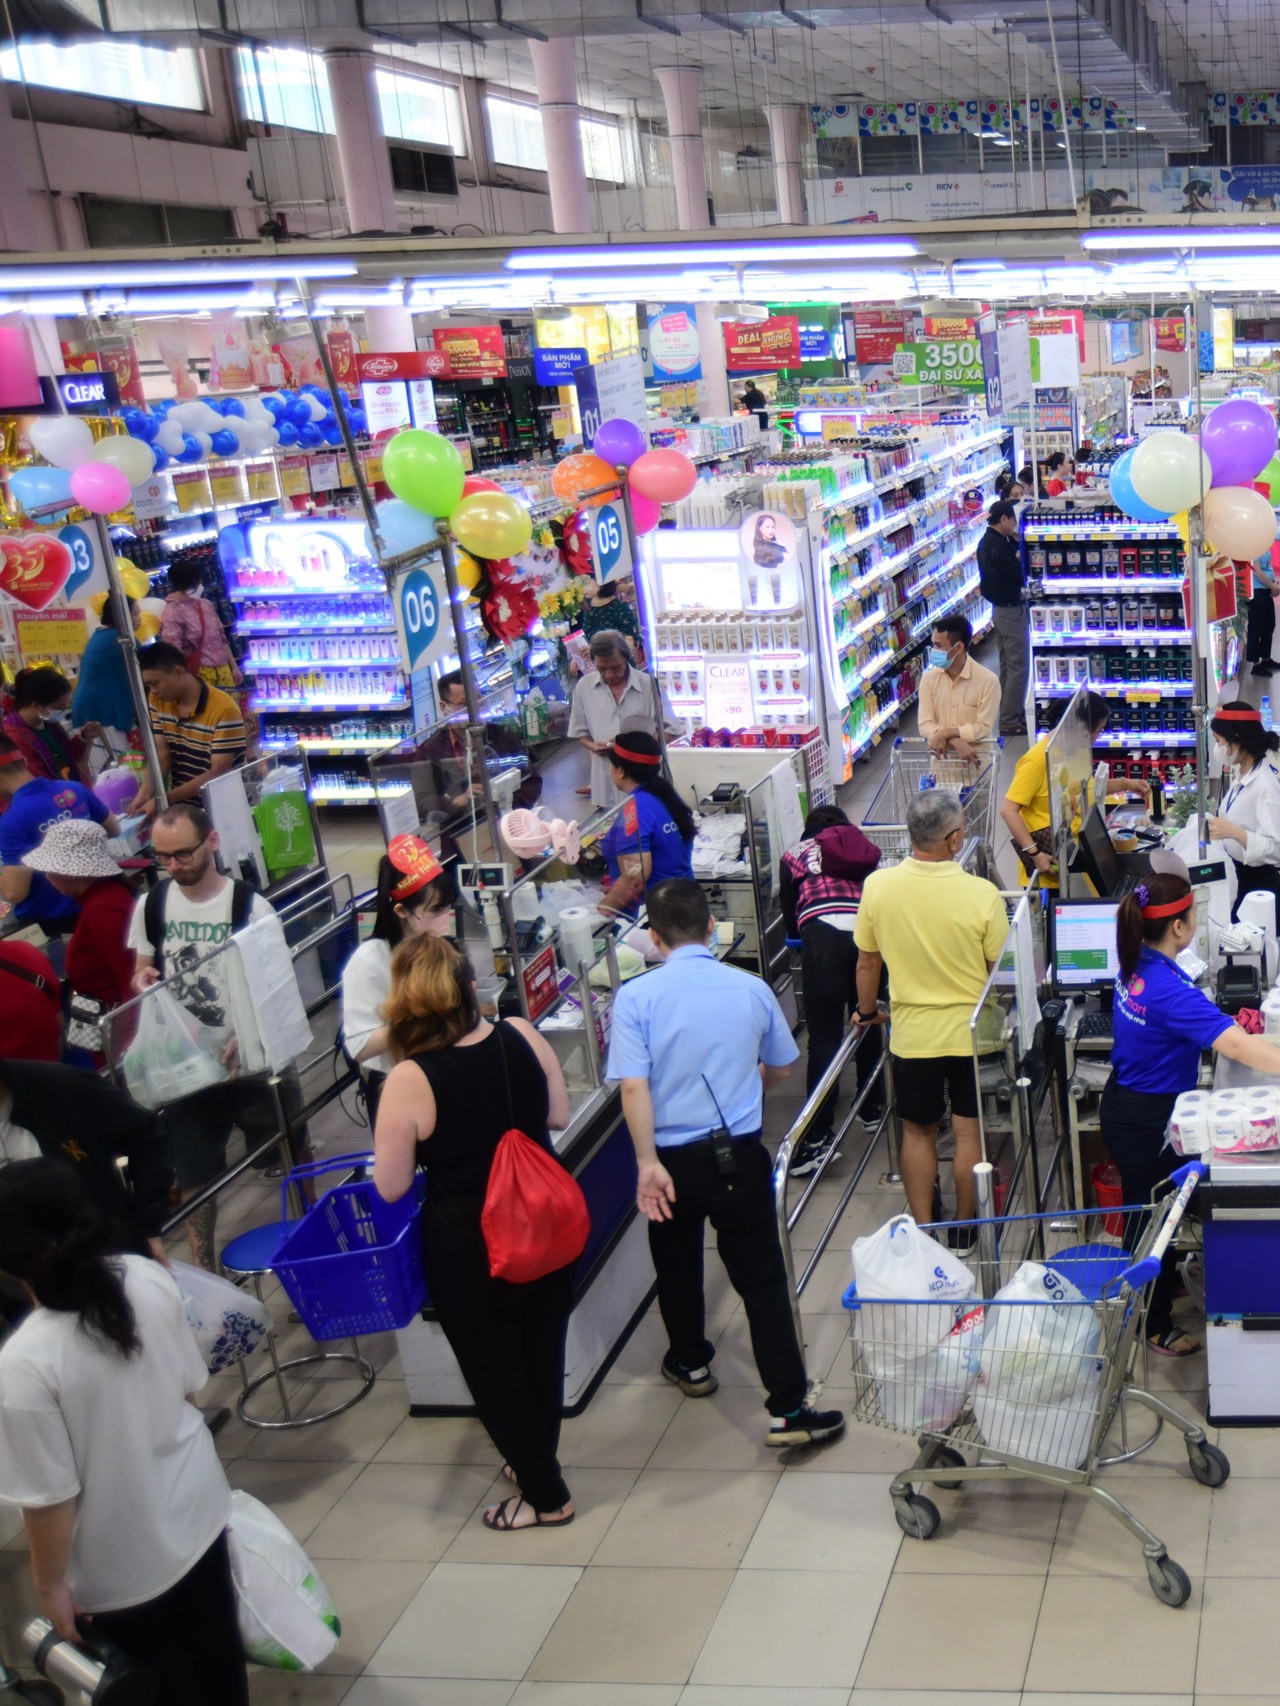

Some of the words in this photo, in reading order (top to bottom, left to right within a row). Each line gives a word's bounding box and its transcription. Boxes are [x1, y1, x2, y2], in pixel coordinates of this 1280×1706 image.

[738, 332, 761, 346] DEAL
[542, 354, 559, 362] SẢN
[559, 352, 582, 362] PHẨM
[508, 365, 533, 380] PASSION
[554, 361, 572, 369] MỚI
[919, 370, 941, 384] ĐẠI
[944, 367, 964, 381] SỨ
[965, 369, 983, 381] XA
[64, 383, 106, 404] CLEAR
[988, 377, 999, 410] 02
[583, 407, 601, 441] 01
[598, 528, 620, 556] 05
[16, 611, 50, 620] Khuyến
[51, 611, 68, 619] mãi
[405, 585, 436, 634] 06
[709, 666, 745, 678] CLEAR
[1215, 1128, 1236, 1136] Select
